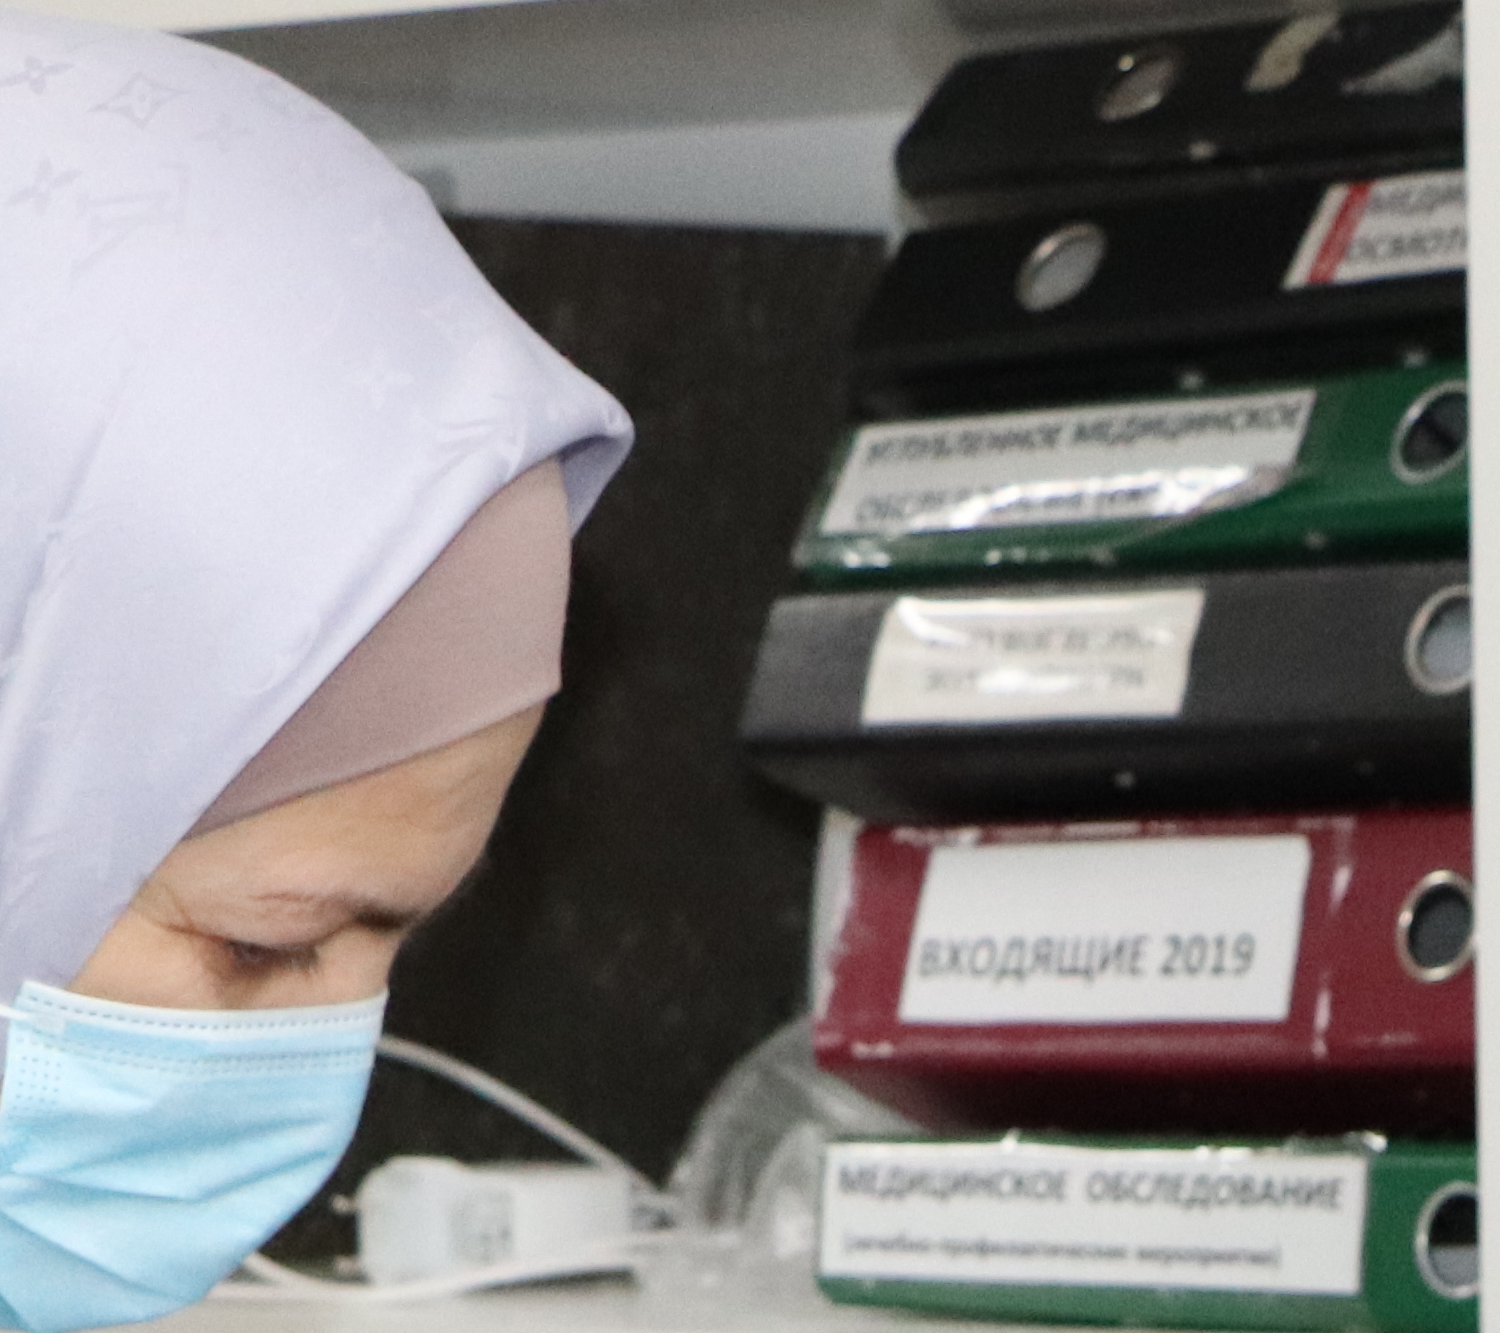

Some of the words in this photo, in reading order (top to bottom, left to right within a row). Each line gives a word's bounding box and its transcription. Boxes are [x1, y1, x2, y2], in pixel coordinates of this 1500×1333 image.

[916, 934, 1150, 983] ВХОДЯЩИЕ
[1158, 932, 1256, 977] 2019
[837, 1165, 1067, 1204] МЕДИЦИНСКОЕ
[1085, 1170, 1344, 1211] ОБСЛЕДОВАНИЕ
